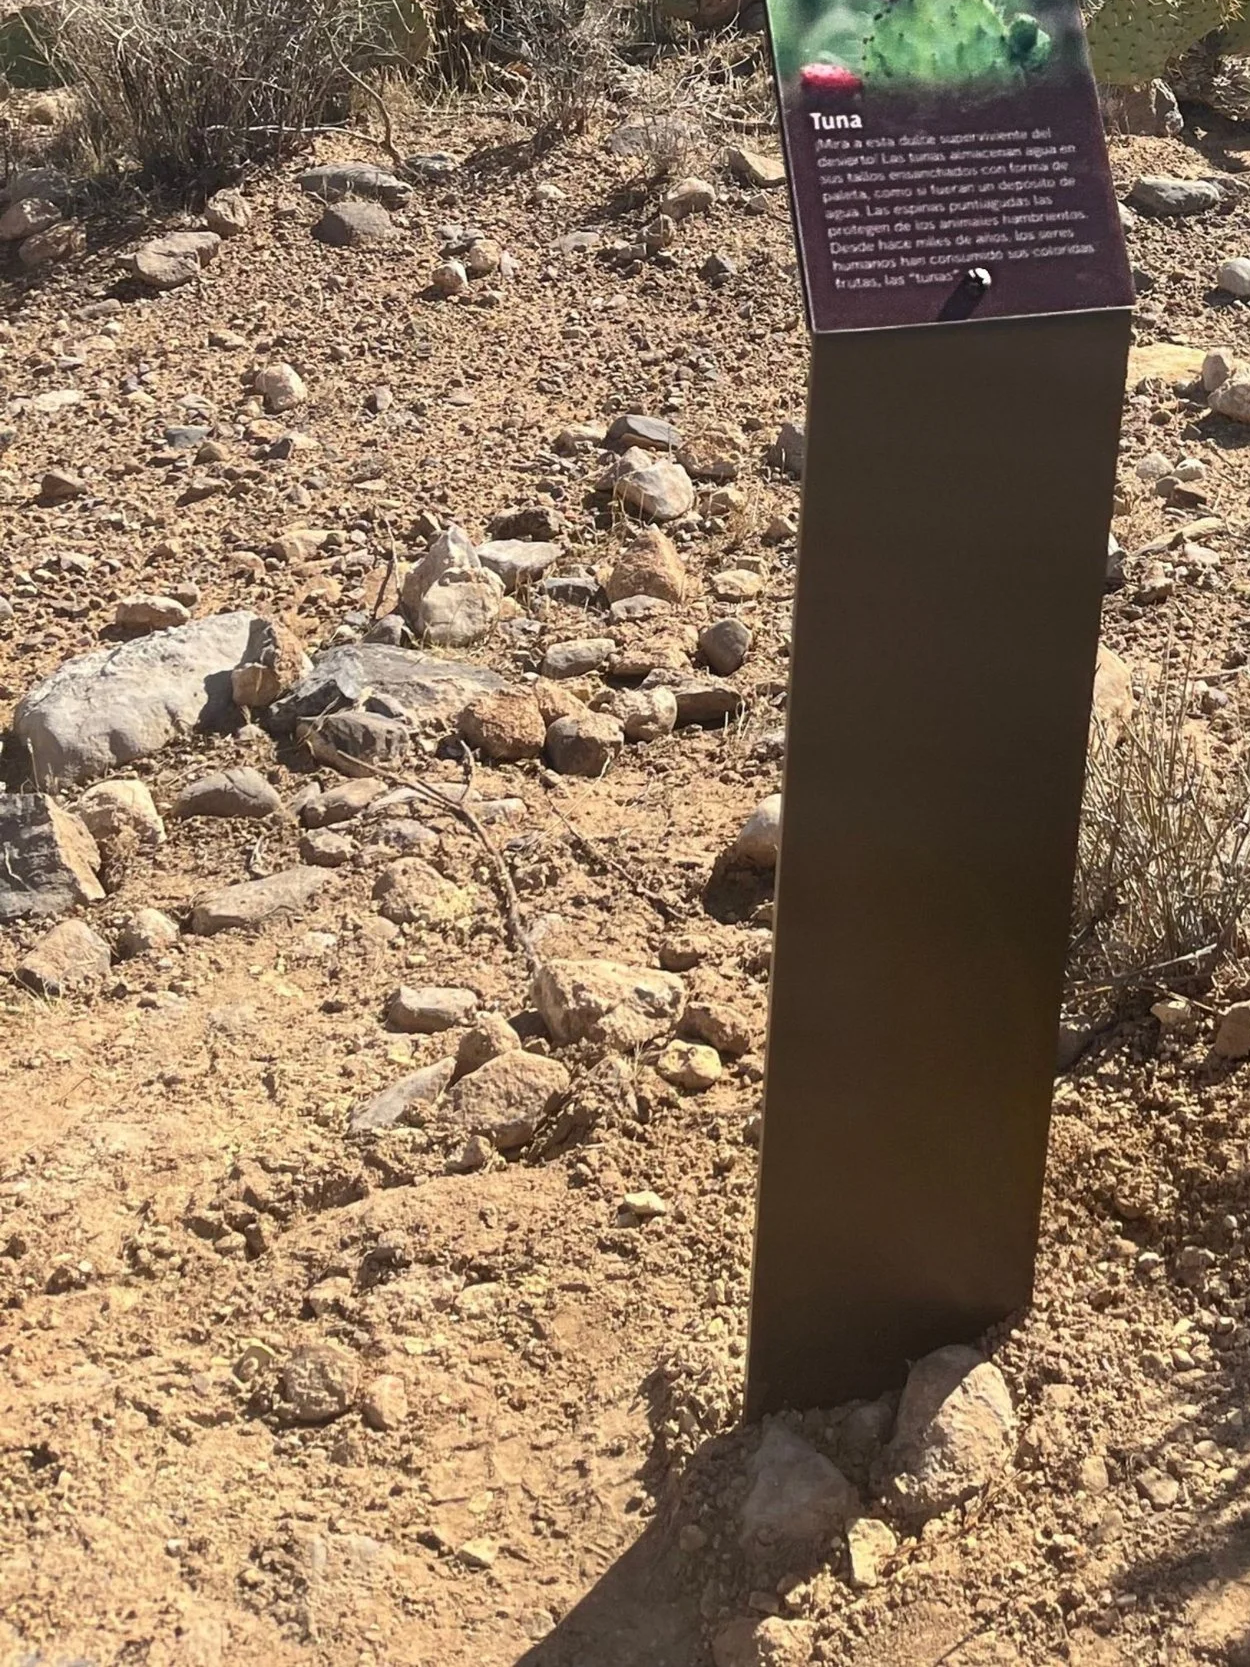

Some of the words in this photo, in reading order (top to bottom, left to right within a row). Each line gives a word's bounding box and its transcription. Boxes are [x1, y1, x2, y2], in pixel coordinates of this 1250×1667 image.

[810, 113, 862, 129] Tuna
[854, 140, 862, 148] a
[866, 138, 895, 148] esta
[899, 134, 935, 146] dulce
[940, 130, 1028, 144] superviviente
[1032, 127, 1051, 139] del
[882, 152, 905, 164] Las
[909, 152, 945, 163] tunas
[949, 147, 1021, 160] almacenan
[1025, 146, 1056, 158] agua
[1060, 144, 1076, 153] en
[820, 174, 842, 184] sus
[848, 170, 885, 182] tallos
[889, 166, 978, 180] ensanchados
[981, 166, 1006, 175] con
[1010, 162, 1049, 174] forma
[1053, 160, 1068, 172] de
[874, 187, 912, 198] como
[917, 185, 926, 196] si
[931, 183, 975, 196] fueran
[979, 183, 995, 192] un
[1059, 176, 1075, 188] de
[866, 204, 890, 217] Las
[894, 201, 945, 215] espinas
[949, 196, 1029, 212] puntiagudas
[1033, 195, 1053, 206] las
[828, 222, 890, 238] protegen
[894, 220, 911, 232] de
[915, 218, 935, 230] los
[939, 215, 999, 229] animales
[830, 241, 874, 254] Desde
[878, 239, 911, 251] hace
[916, 236, 951, 248] miles
[955, 234, 972, 245] de
[1015, 230, 1034, 241] los
[833, 257, 896, 271] humanos
[900, 256, 926, 267] han
[930, 249, 1003, 265] consumido
[1008, 249, 1029, 259] sus
[1033, 243, 1094, 257] coloridas
[836, 275, 881, 289] frutas,
[884, 273, 905, 286] las
